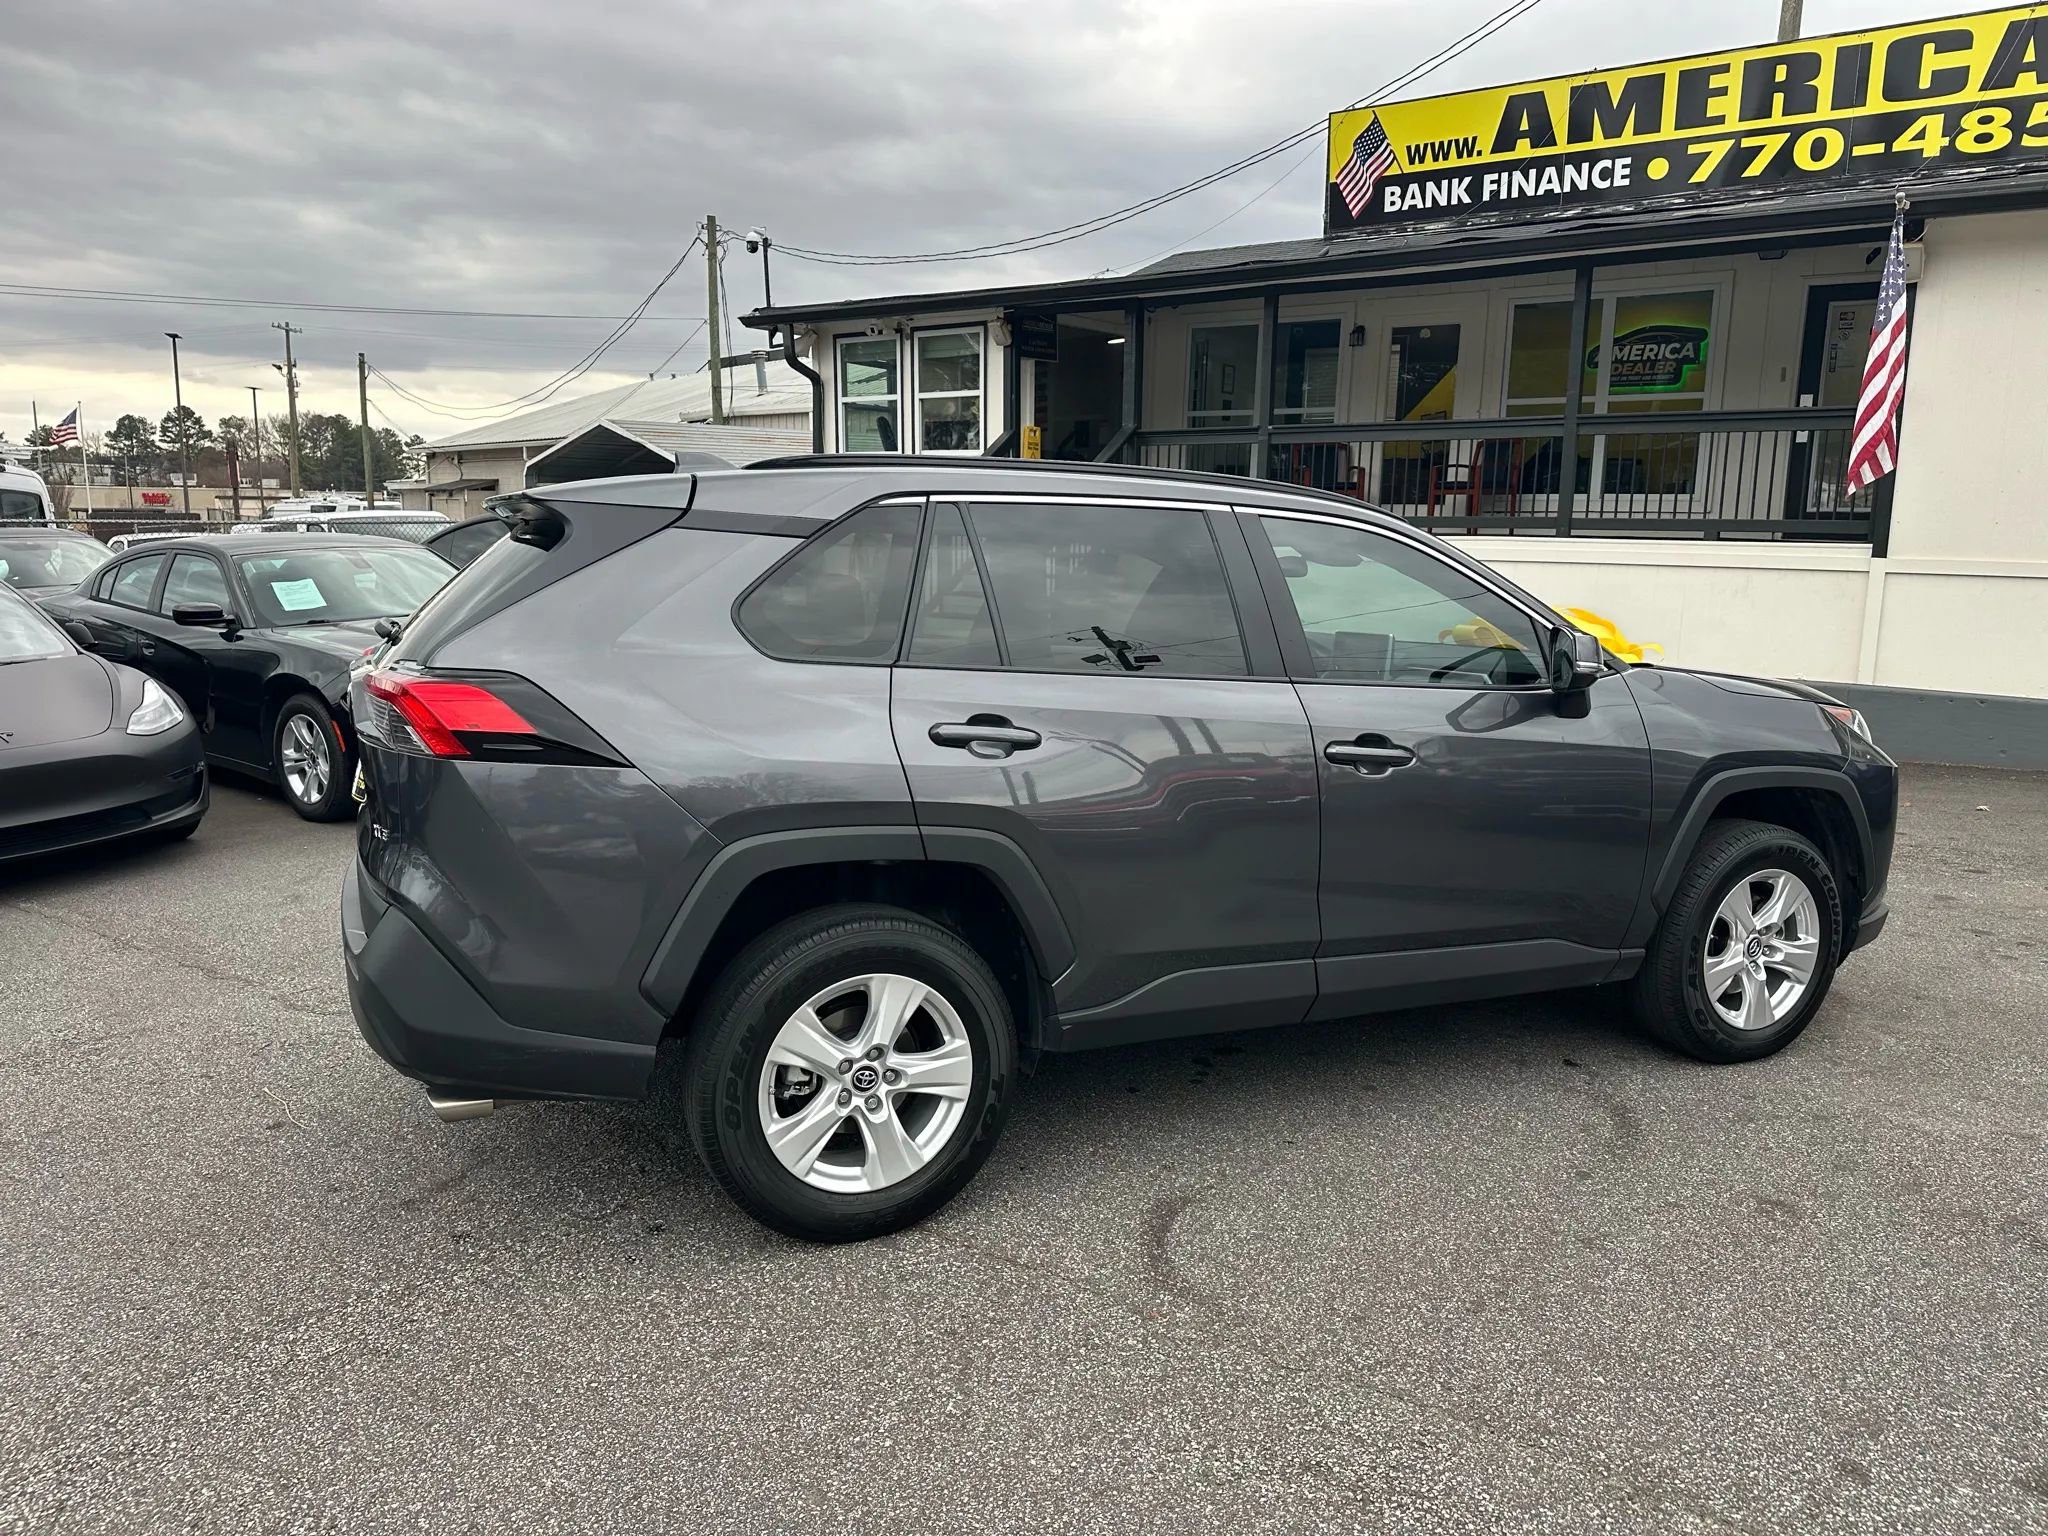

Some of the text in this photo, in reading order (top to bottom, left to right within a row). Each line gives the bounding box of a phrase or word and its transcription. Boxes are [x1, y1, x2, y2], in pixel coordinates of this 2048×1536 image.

[1489, 15, 2048, 155] AMERICA
[1383, 157, 1633, 213] BANK FINANCE
[1611, 360, 1677, 375] DEALER
